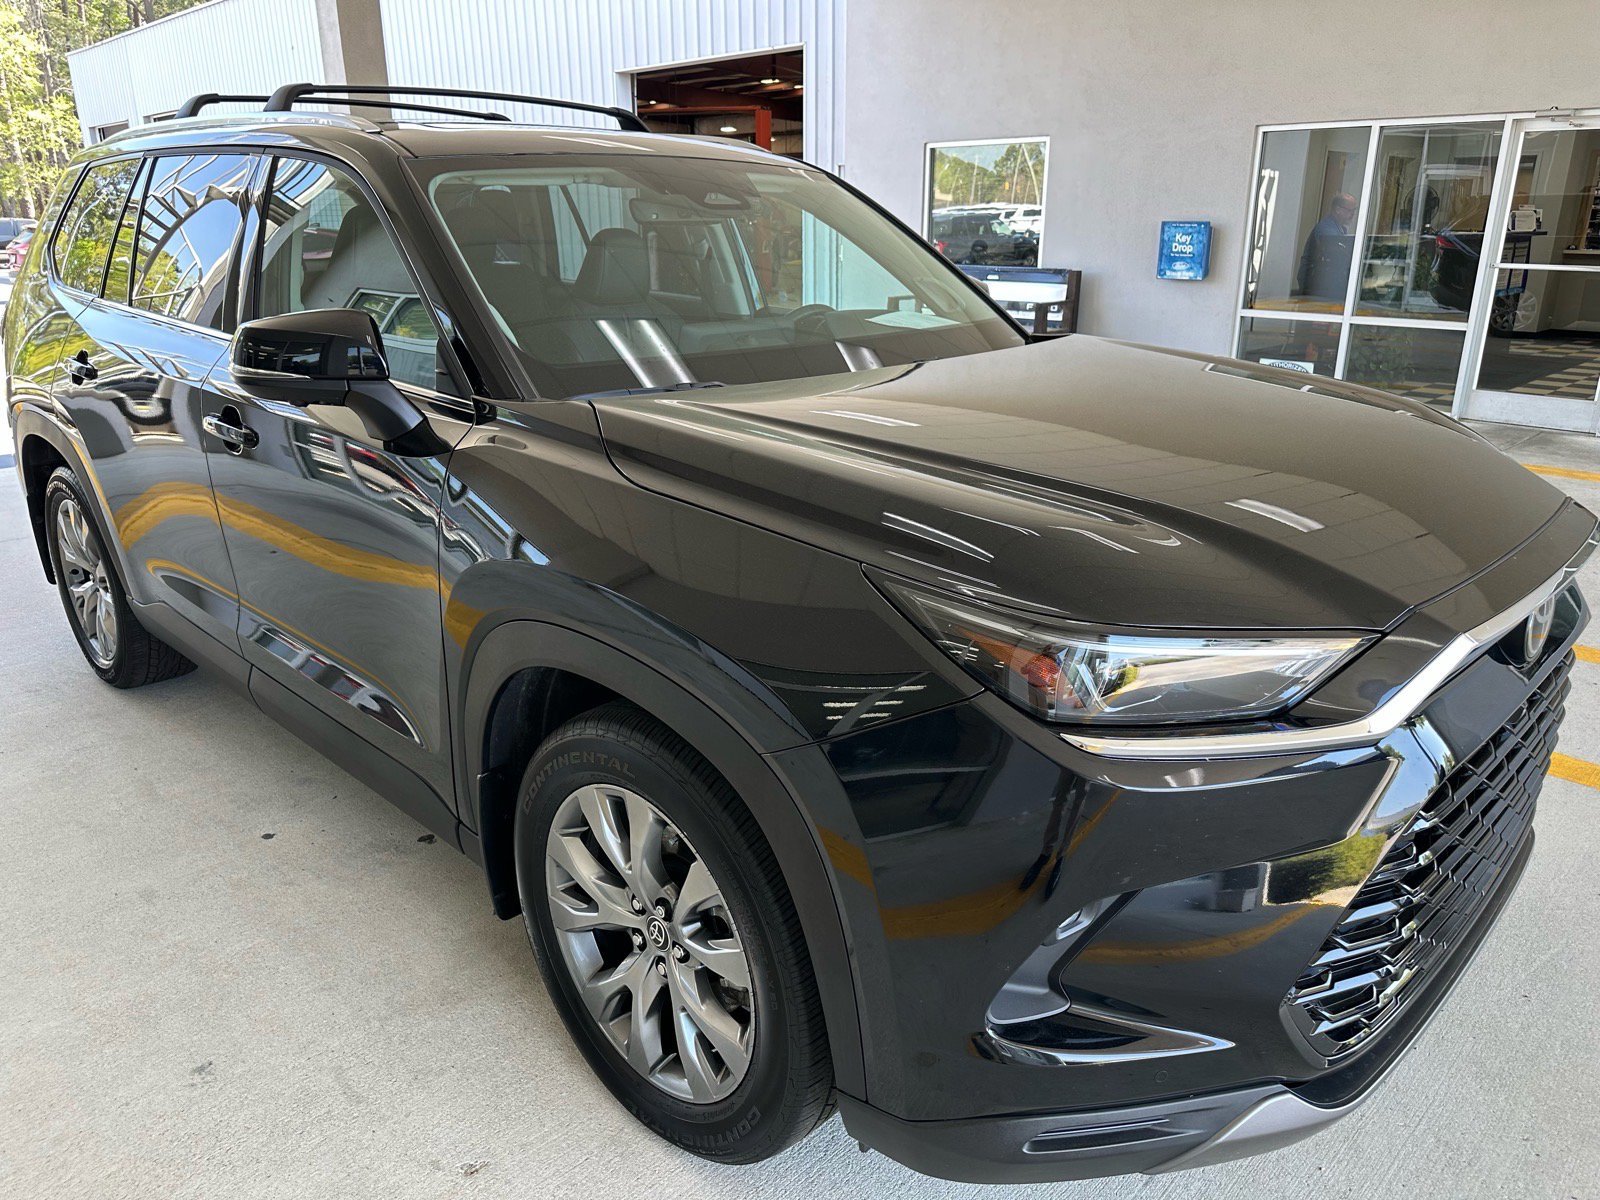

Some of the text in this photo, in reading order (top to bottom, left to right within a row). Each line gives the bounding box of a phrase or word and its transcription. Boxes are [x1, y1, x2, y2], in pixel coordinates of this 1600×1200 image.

[1175, 232, 1192, 245] Key
[1172, 243, 1194, 254] Drop
[1026, 302, 1059, 312] FD
[1270, 361, 1308, 374] UTHORIZED
[523, 751, 636, 815] CONTINENTAL
